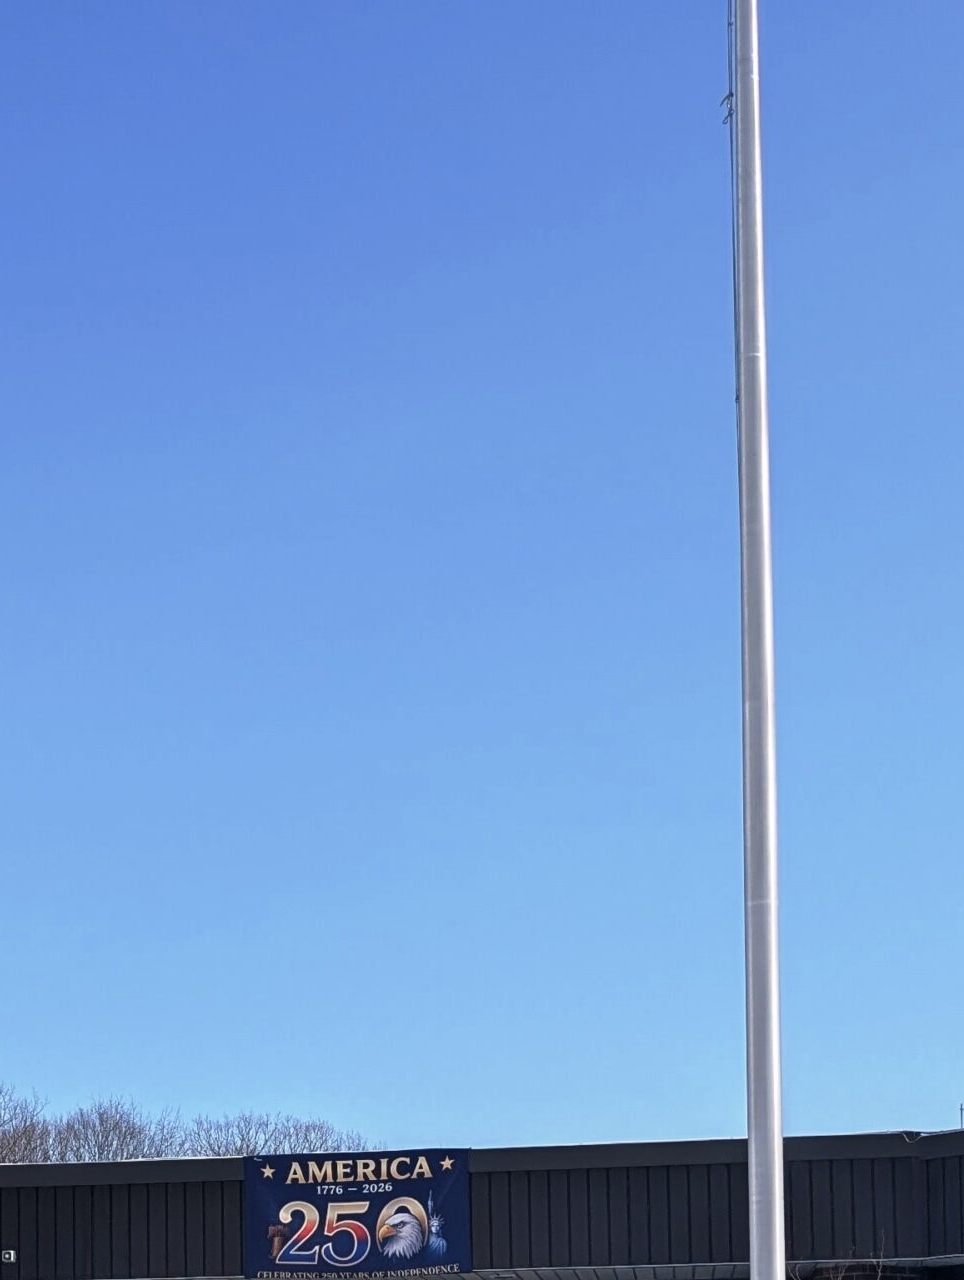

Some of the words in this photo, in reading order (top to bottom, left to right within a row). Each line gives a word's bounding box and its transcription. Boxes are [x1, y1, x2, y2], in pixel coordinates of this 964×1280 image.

[286, 1156, 433, 1184] AMERICA
[317, 1185, 343, 1195] 1776
[362, 1182, 393, 1194] 2026
[276, 1196, 428, 1266] 250
[257, 1271, 320, 1279] CELEBRATING
[387, 1263, 460, 1278] INDEPENDENCE
